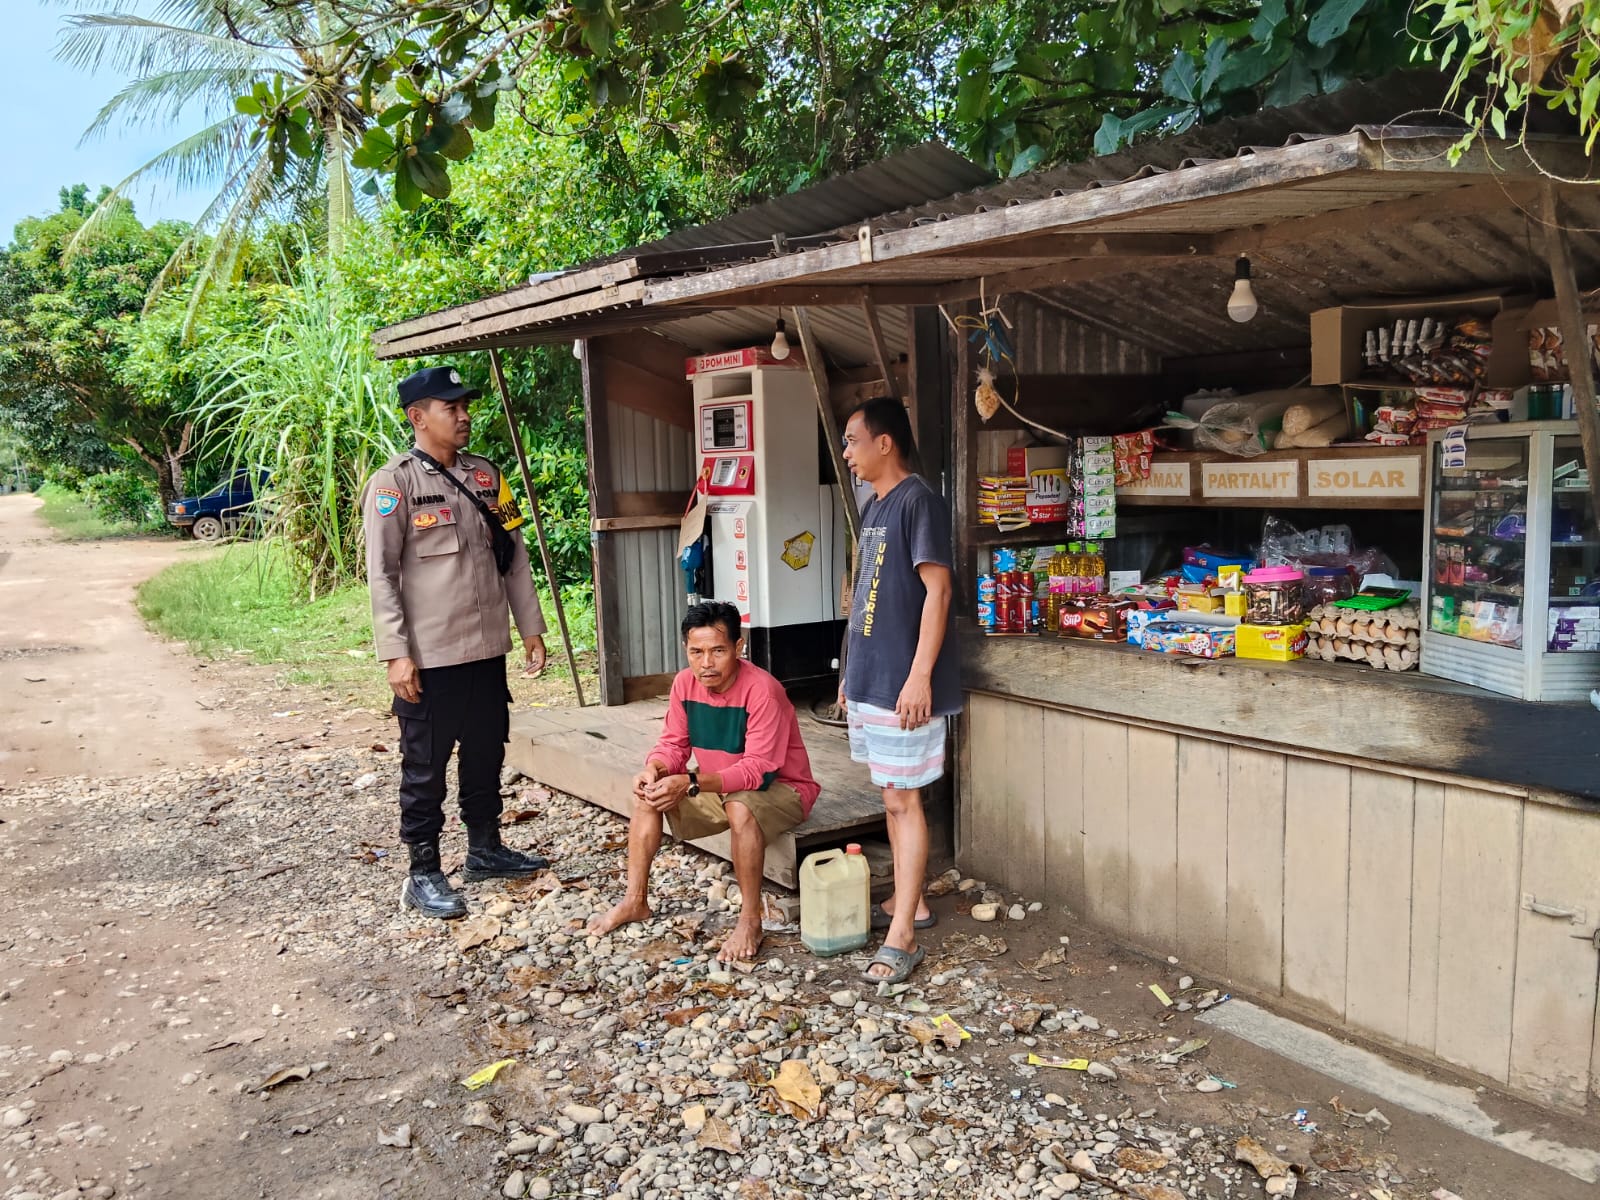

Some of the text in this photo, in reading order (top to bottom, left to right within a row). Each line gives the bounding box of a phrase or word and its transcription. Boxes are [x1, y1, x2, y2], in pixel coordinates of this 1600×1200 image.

[1208, 471, 1290, 489] PARTALIT
[1317, 470, 1406, 489] SOLAR
[1031, 508, 1039, 519] 5
[863, 541, 887, 637] UNIVERSE
